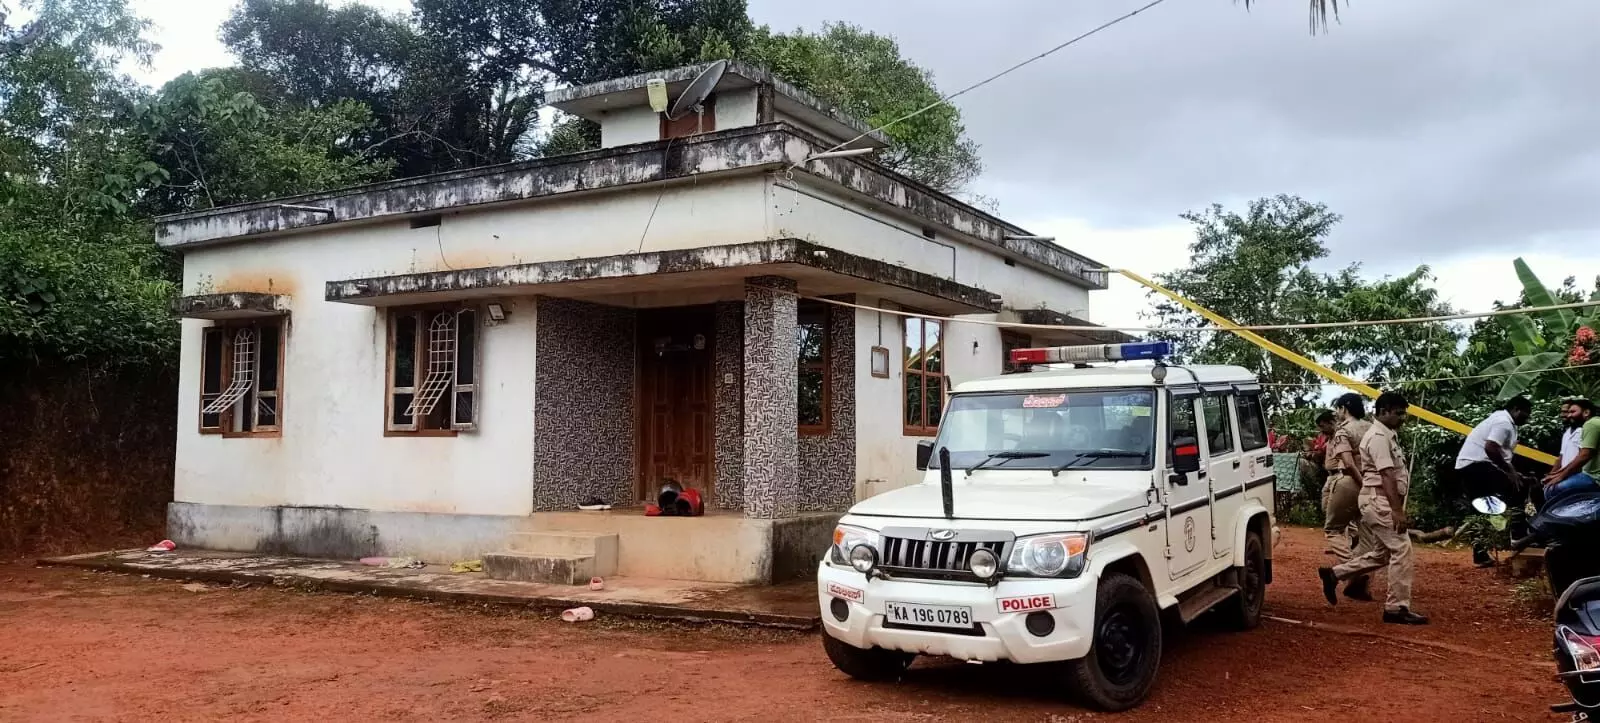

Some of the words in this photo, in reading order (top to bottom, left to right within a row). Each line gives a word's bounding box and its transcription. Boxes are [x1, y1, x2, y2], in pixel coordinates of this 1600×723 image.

[1002, 596, 1051, 611] POLICE
[894, 606, 909, 621] KA
[912, 607, 935, 623] 19G
[937, 609, 970, 625] 0789
